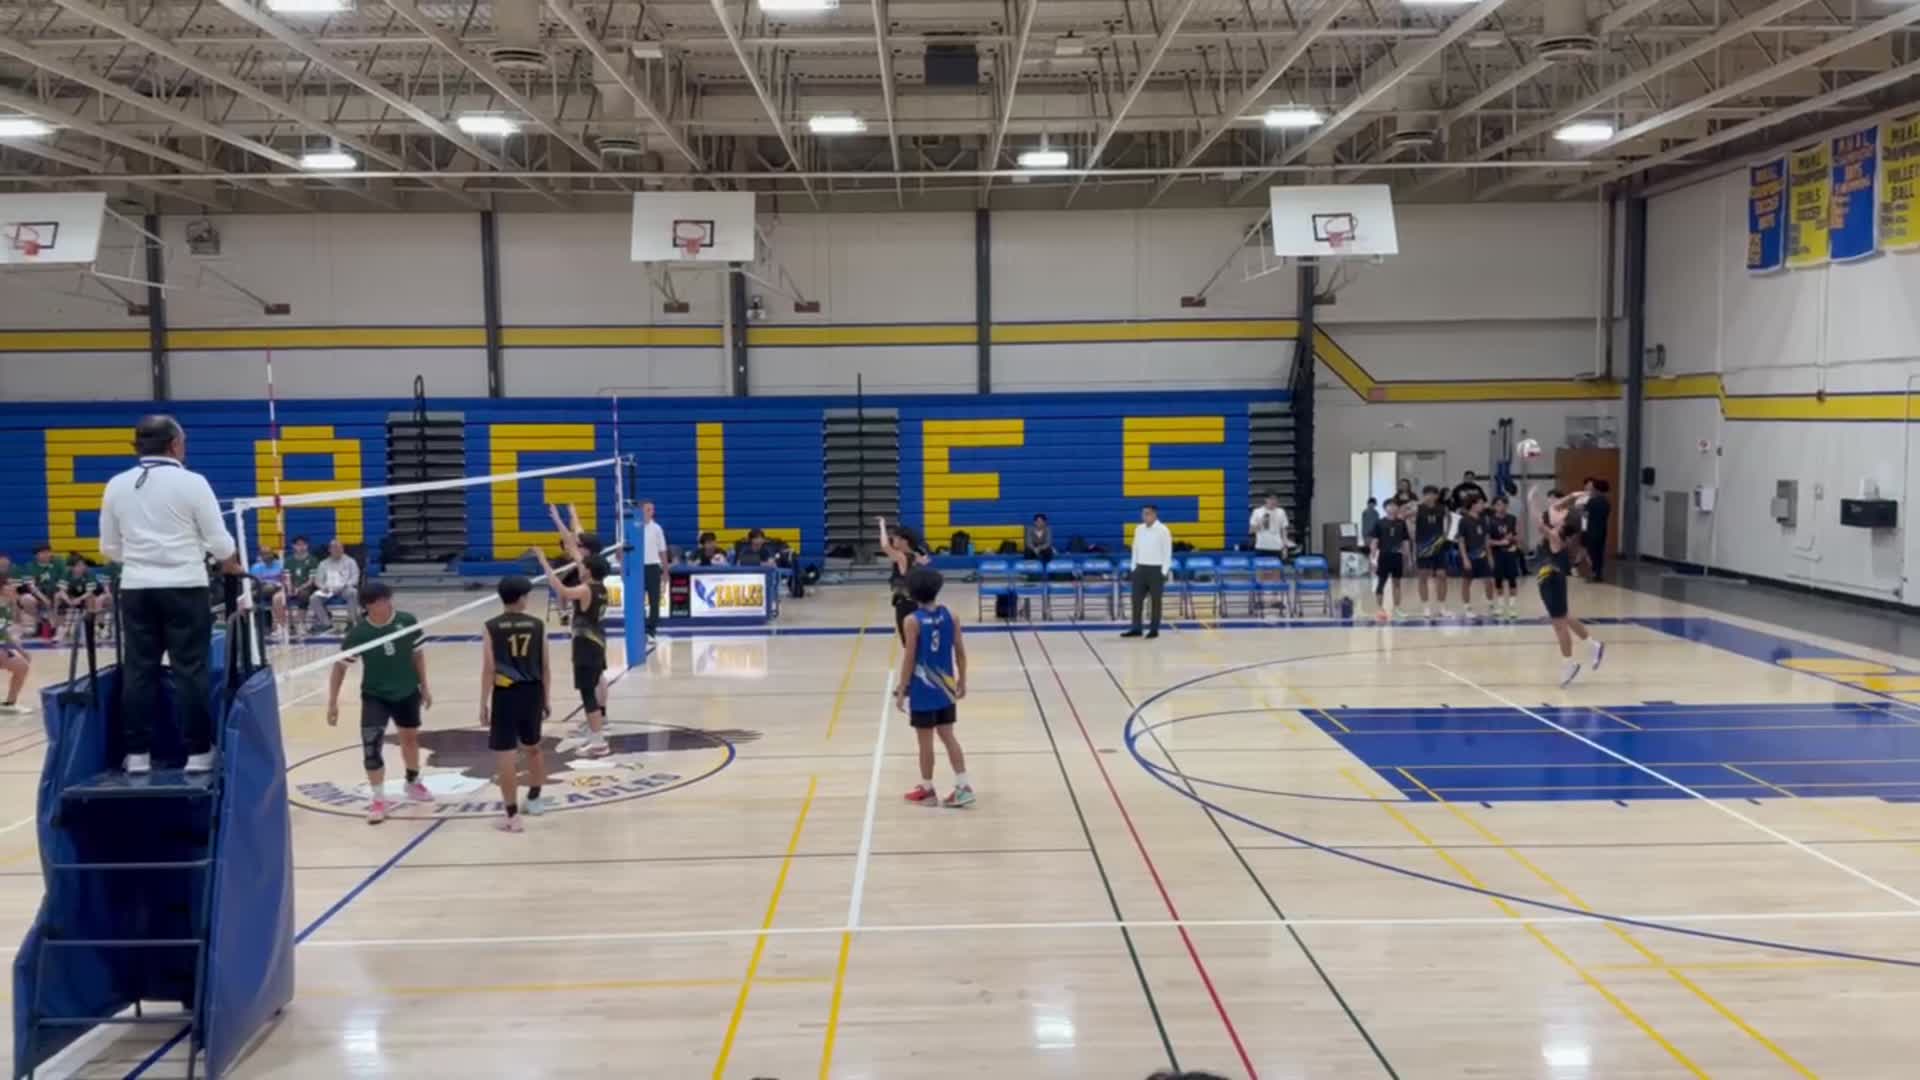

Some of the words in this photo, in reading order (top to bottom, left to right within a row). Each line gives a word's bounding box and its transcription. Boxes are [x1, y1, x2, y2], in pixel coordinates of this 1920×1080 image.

[45, 415, 1226, 567] EAGLES
[507, 633, 532, 657] 17
[930, 629, 940, 653] 3
